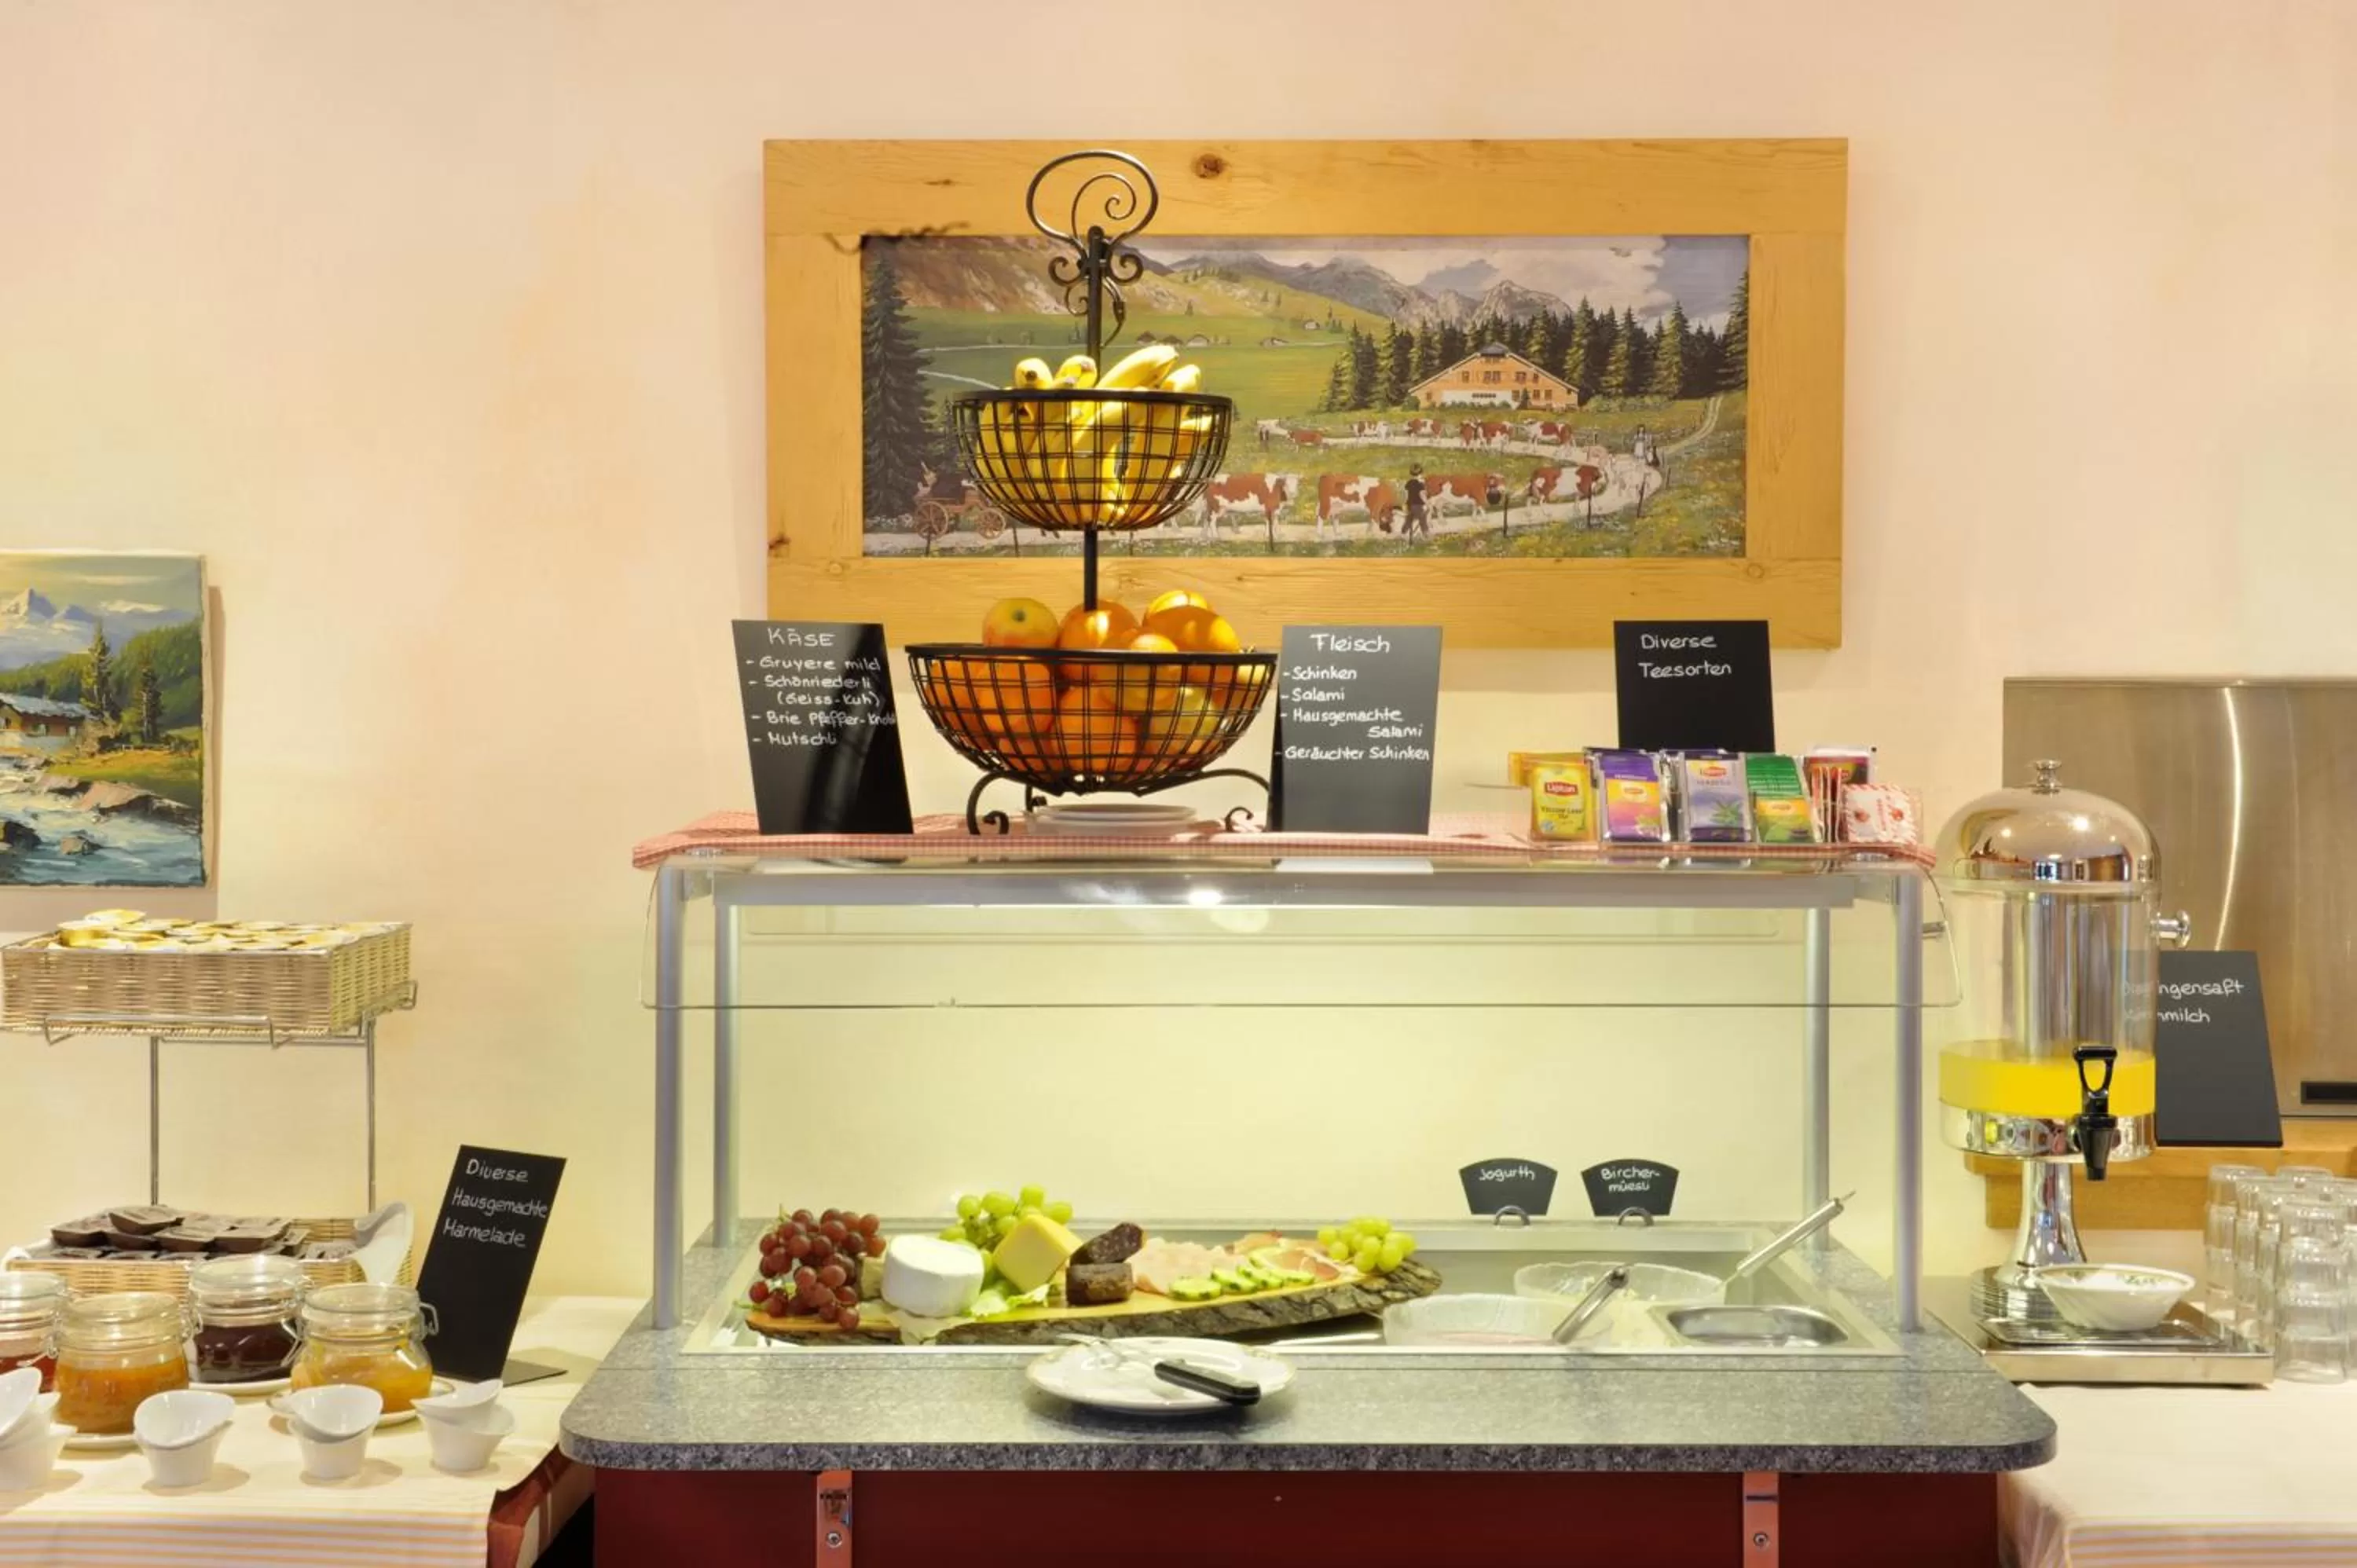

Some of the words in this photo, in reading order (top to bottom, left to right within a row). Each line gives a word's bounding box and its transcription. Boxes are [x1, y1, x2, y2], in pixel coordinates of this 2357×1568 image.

[1310, 633, 1391, 653] Fleisch
[1640, 633, 1717, 650] Diverse
[760, 656, 836, 672] Gruyere
[845, 658, 881, 671] mild
[1637, 660, 1732, 678] Teesorten
[1292, 666, 1358, 680] Schinken
[1291, 687, 1346, 702] Salami
[767, 711, 802, 725] Brie
[1293, 707, 1405, 727] Hausgemachte
[1367, 724, 1424, 738] Salami
[1369, 745, 1430, 760] Schinken
[465, 1159, 529, 1182] Diverse
[451, 1186, 548, 1218] Hausgemachte
